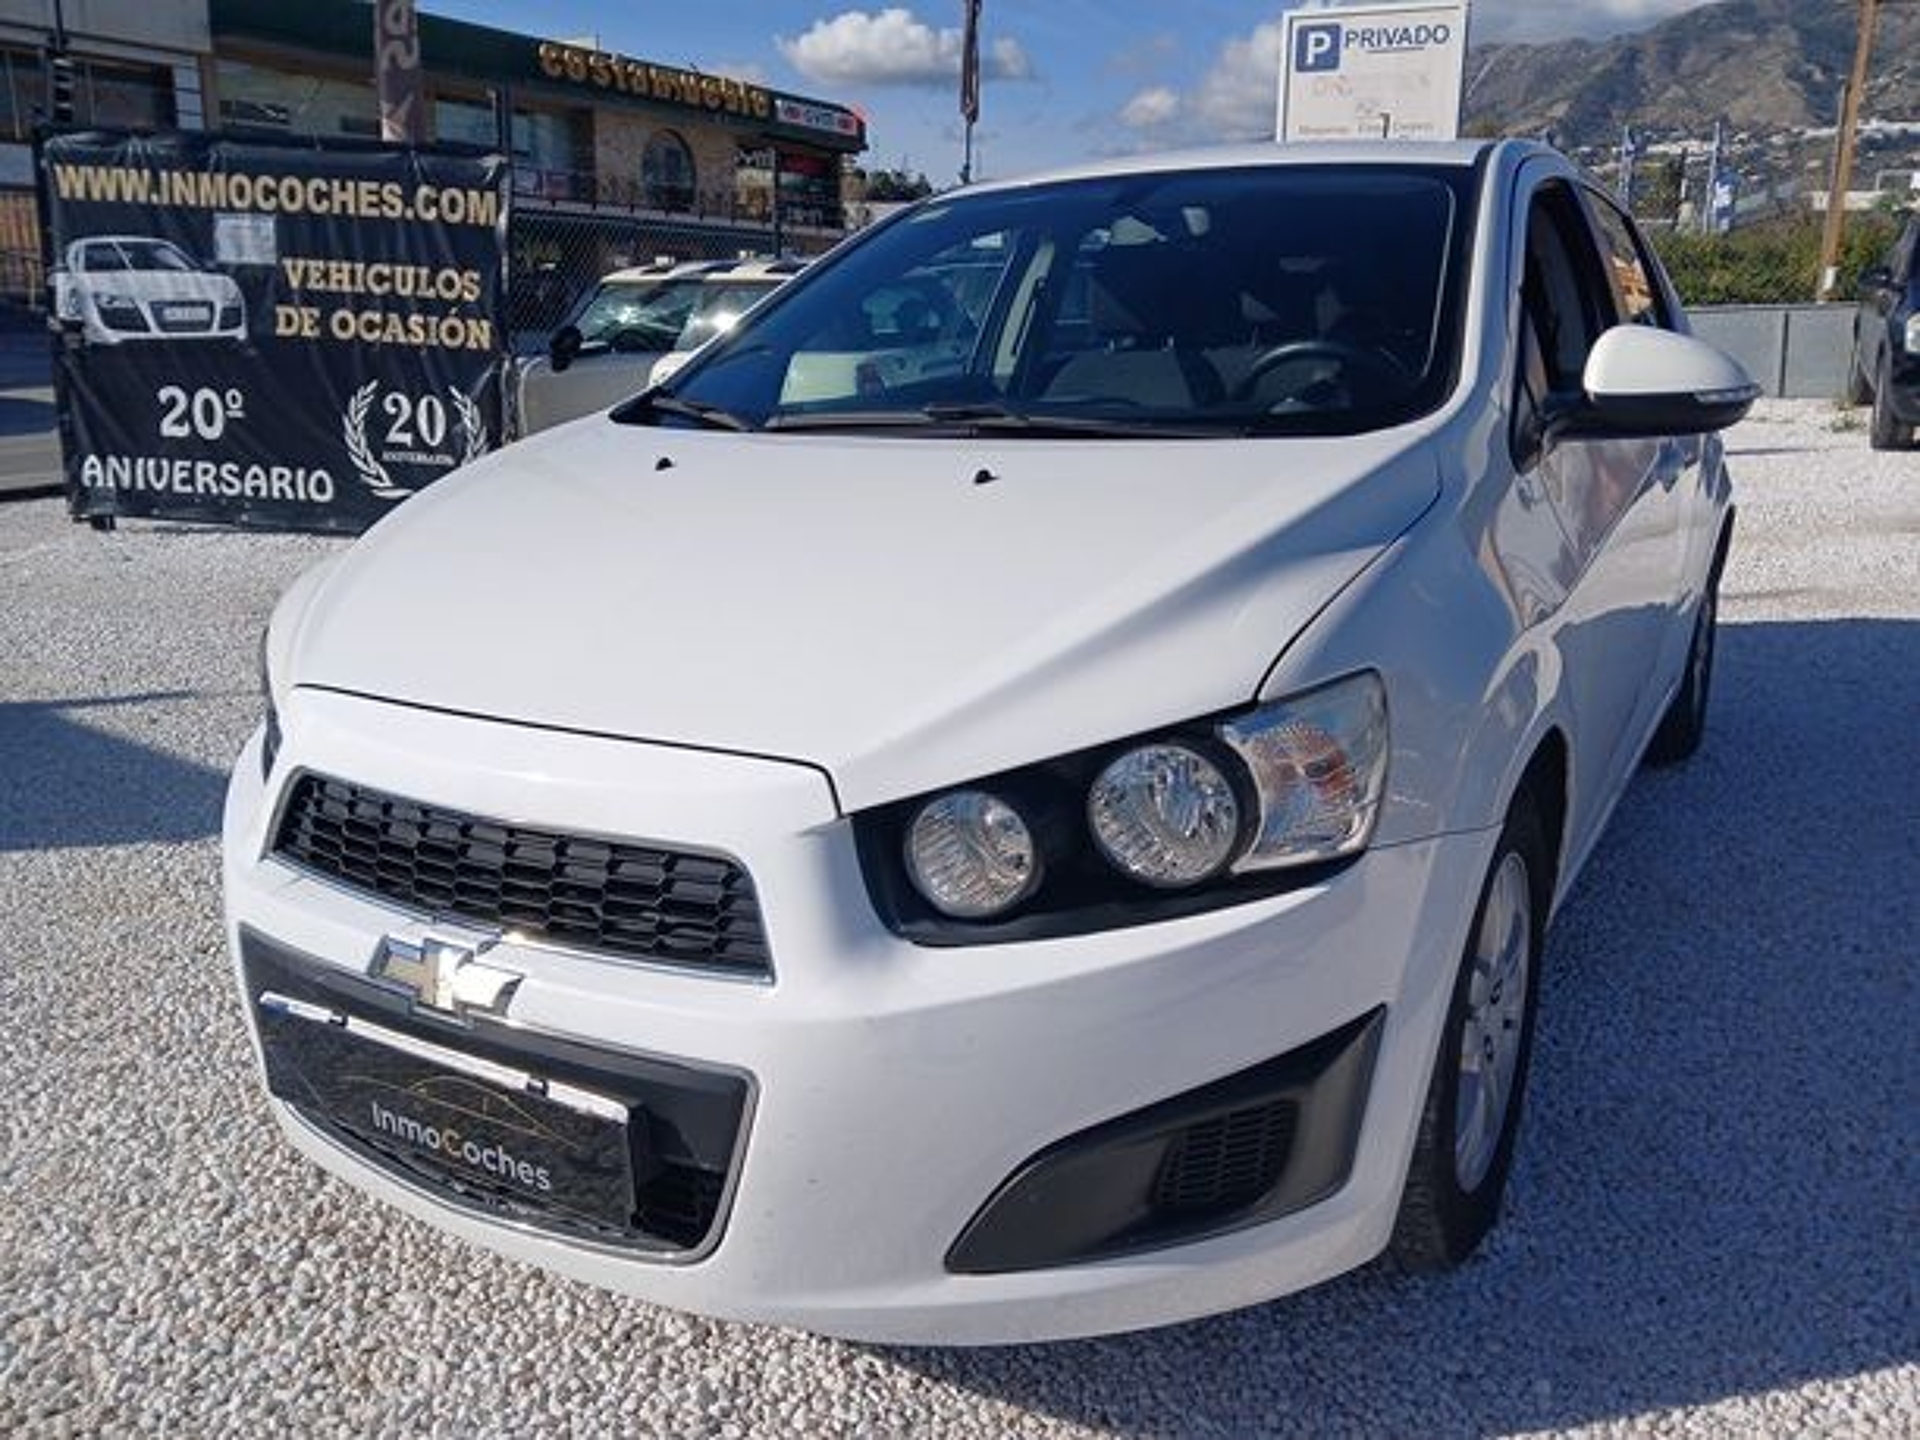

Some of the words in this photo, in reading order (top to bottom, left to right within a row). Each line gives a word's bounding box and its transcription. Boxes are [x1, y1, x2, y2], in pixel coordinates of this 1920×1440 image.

[1305, 30, 1331, 65] P
[1344, 24, 1450, 49] PRIVADO
[54, 164, 498, 226] WWW.INMOCOCHES.COM
[281, 257, 482, 301] VEHICULOS
[275, 306, 321, 338] DE
[331, 306, 492, 349] OCASIÓN
[383, 392, 447, 448] 20
[80, 453, 334, 502] ANIVERSARIO
[371, 1101, 551, 1191] InmoCoches
